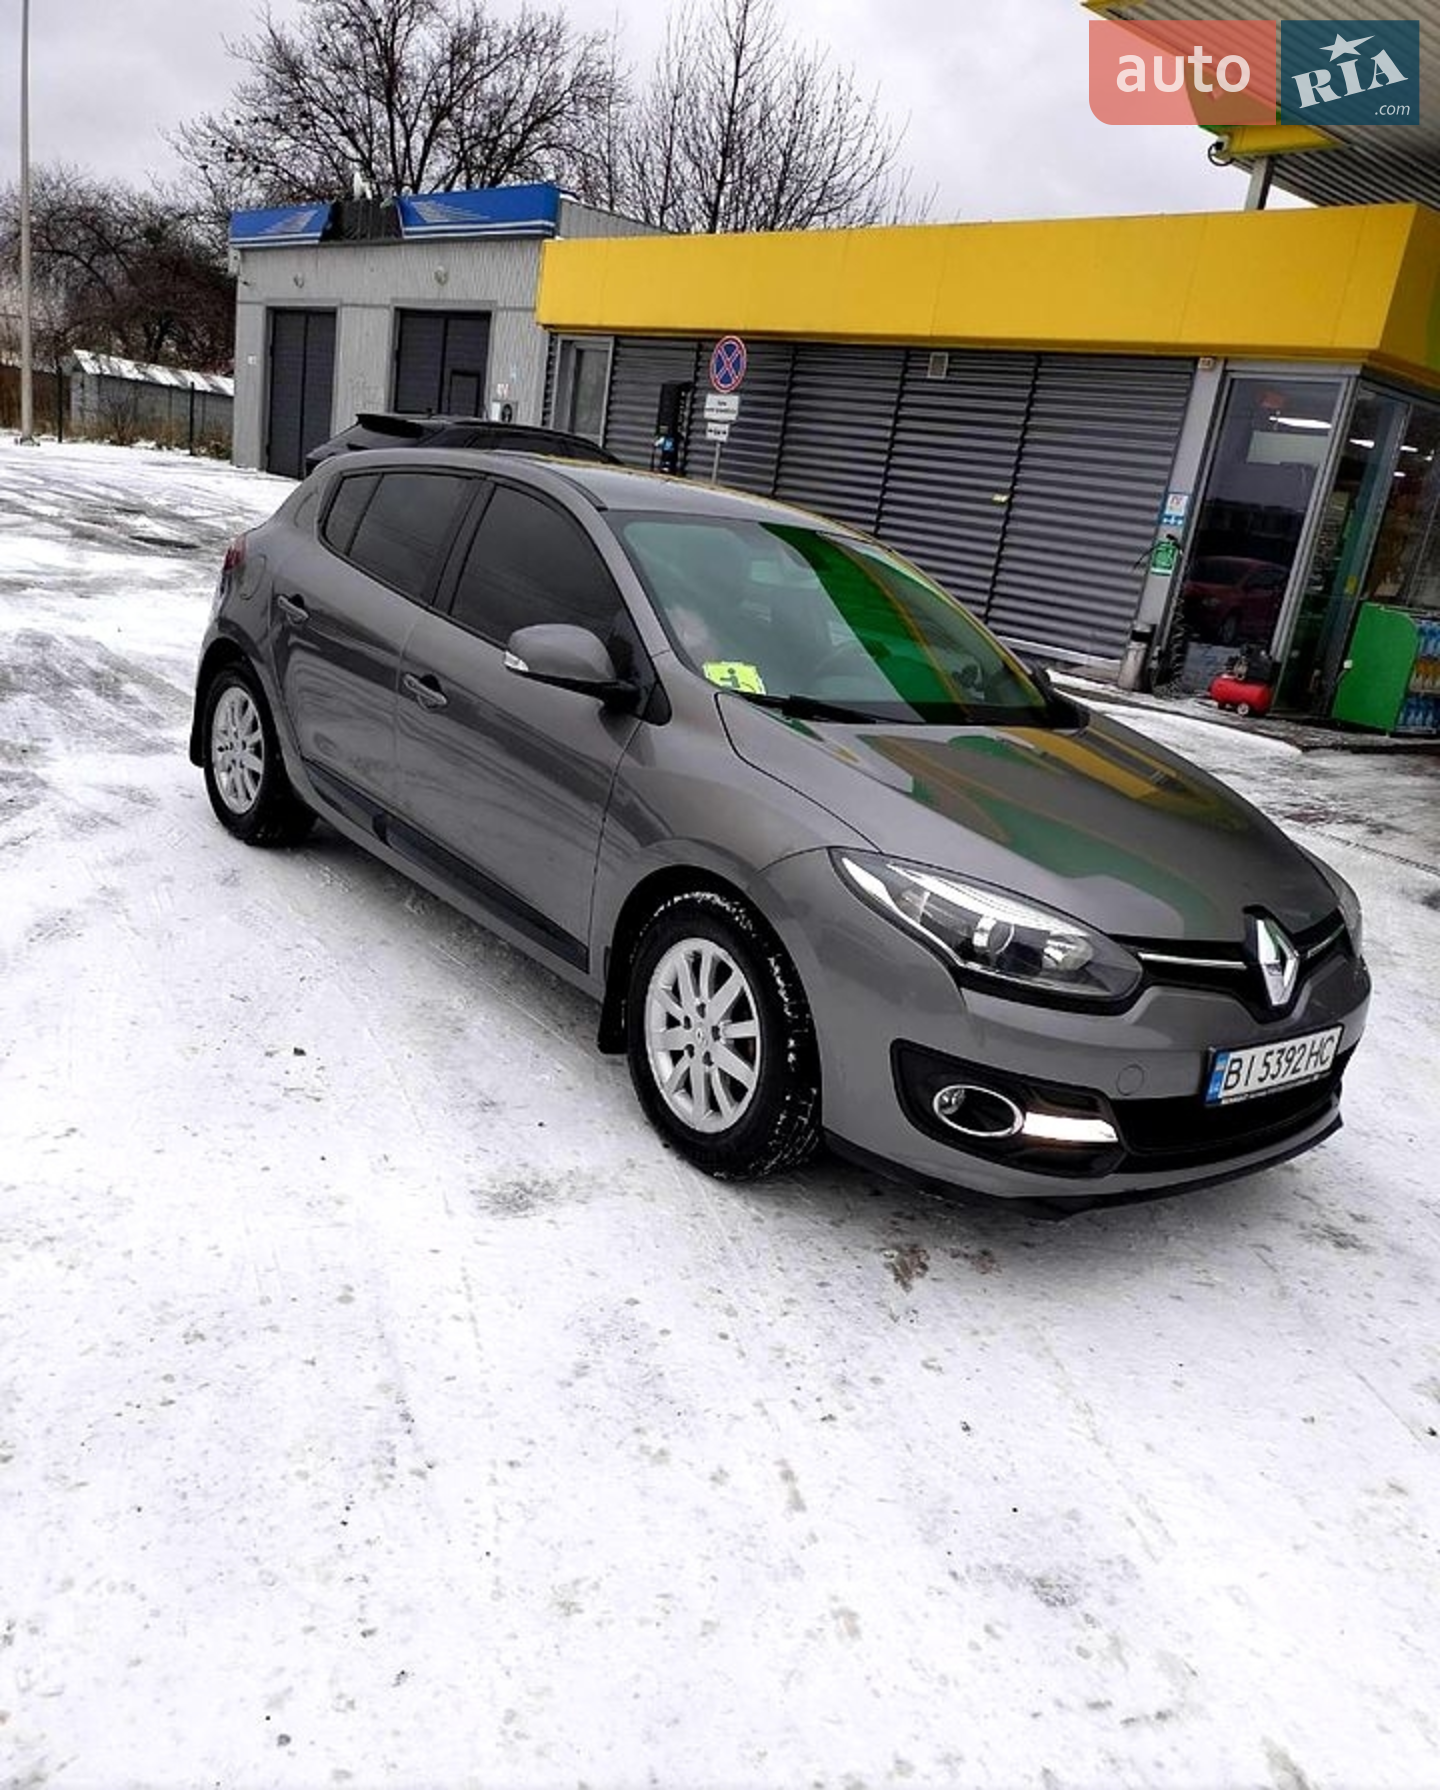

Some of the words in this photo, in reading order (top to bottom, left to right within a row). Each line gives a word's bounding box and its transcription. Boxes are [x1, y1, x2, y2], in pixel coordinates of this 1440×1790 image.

[1223, 1055, 1256, 1091] BI
[1257, 1043, 1307, 1083] 5392
[1305, 1035, 1335, 1070] HC
